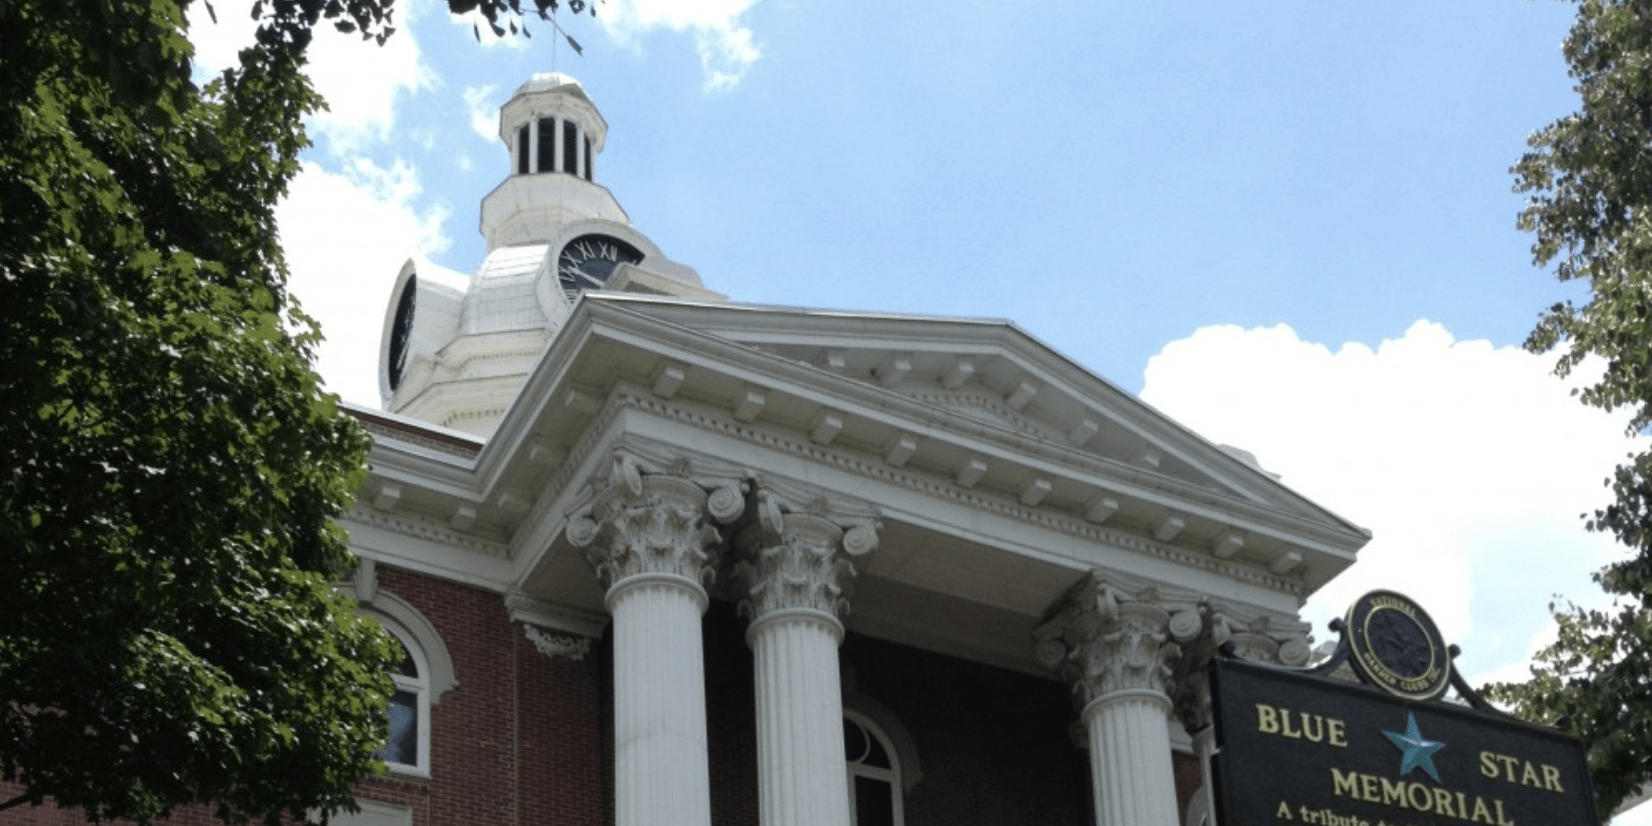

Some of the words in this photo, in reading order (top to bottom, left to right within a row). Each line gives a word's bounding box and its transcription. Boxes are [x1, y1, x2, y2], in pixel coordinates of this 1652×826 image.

[597, 240, 618, 262] XII
[1256, 704, 1348, 748] BLUE
[1479, 751, 1565, 793] STAR
[1276, 801, 1293, 820] A
[1330, 767, 1514, 826] MEMORIAL
